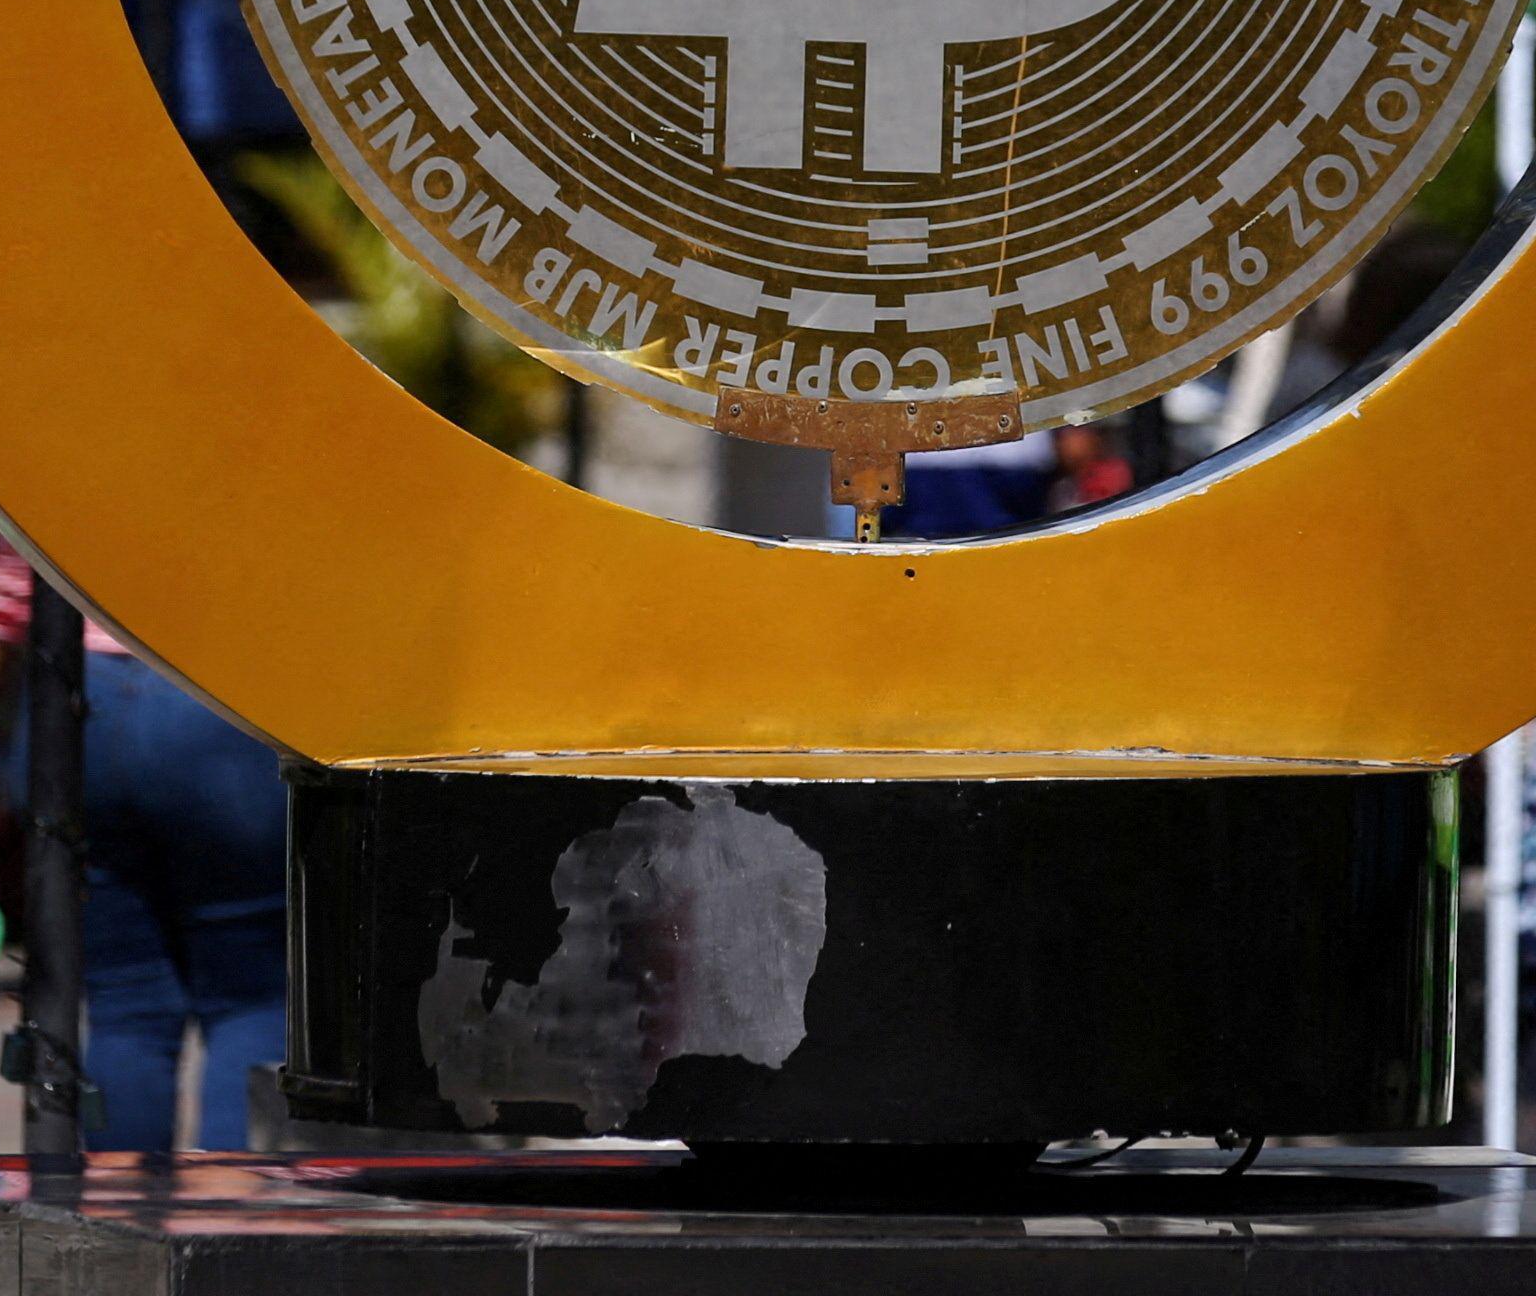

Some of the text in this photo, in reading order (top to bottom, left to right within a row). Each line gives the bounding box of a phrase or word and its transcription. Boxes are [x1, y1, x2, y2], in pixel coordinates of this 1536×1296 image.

[525, 246, 658, 349] MJB
[1151, 229, 1269, 335] 999
[673, 315, 950, 401] COPPER
[978, 305, 1130, 387] FINE
